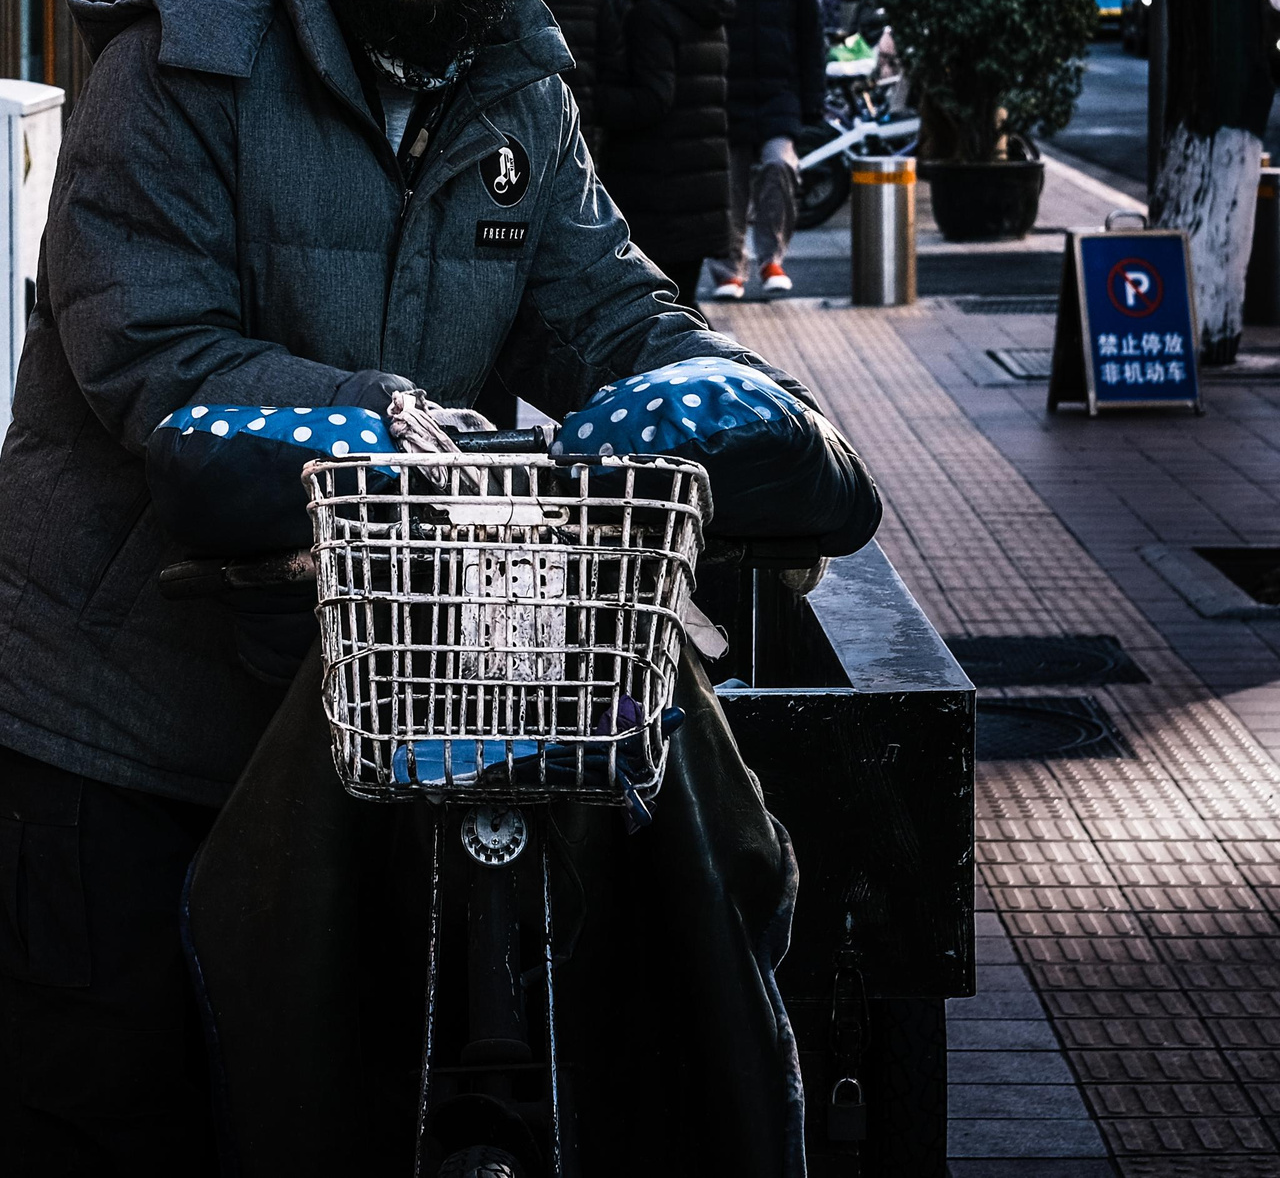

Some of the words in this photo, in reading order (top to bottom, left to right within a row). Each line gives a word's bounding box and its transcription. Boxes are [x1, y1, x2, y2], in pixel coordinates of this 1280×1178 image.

[483, 227, 506, 239] FREE
[509, 228, 525, 239] FLY
[1097, 332, 1183, 356] 禁止停放
[1100, 360, 1186, 384] 非机动车
